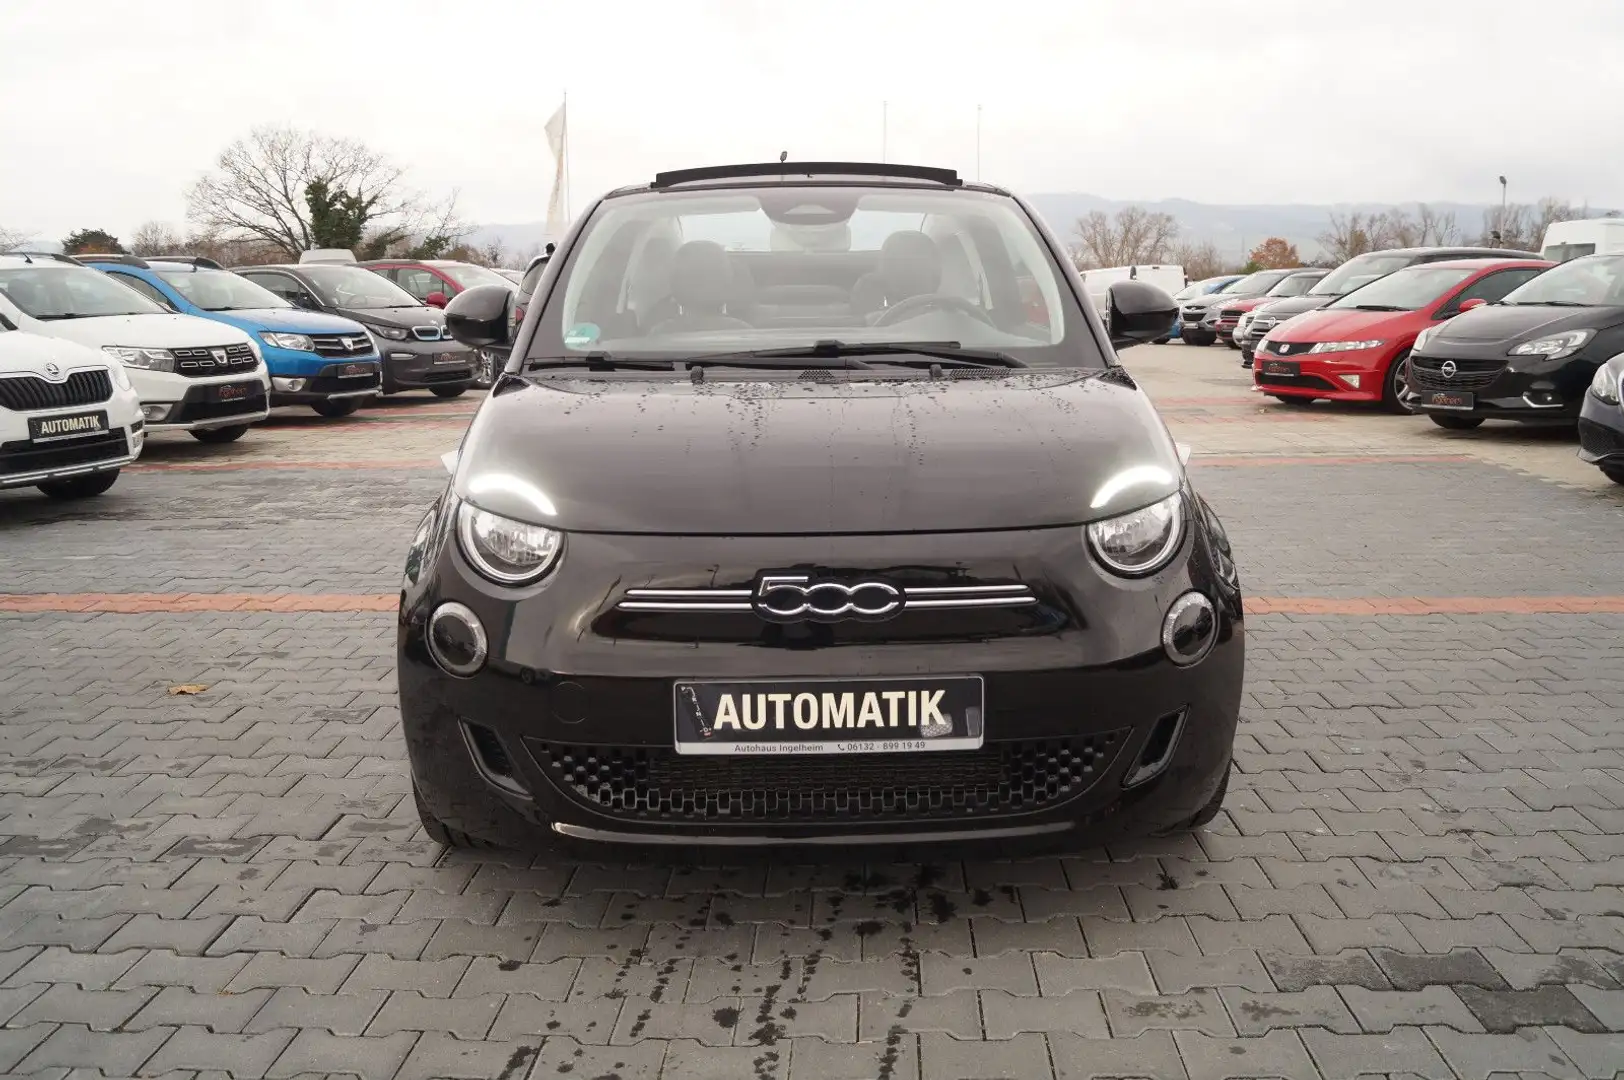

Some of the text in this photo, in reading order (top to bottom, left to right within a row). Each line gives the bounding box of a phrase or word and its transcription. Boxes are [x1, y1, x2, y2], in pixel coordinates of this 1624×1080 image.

[41, 415, 101, 434] AUTOMATIK
[757, 576, 900, 615] 500
[713, 690, 946, 730] AUTOMATIK
[734, 743, 824, 754] Autohaus Ingelheim
[847, 742, 875, 751] 06132
[882, 742, 899, 750] 899
[902, 742, 912, 750] 19
[914, 741, 926, 749] 49
